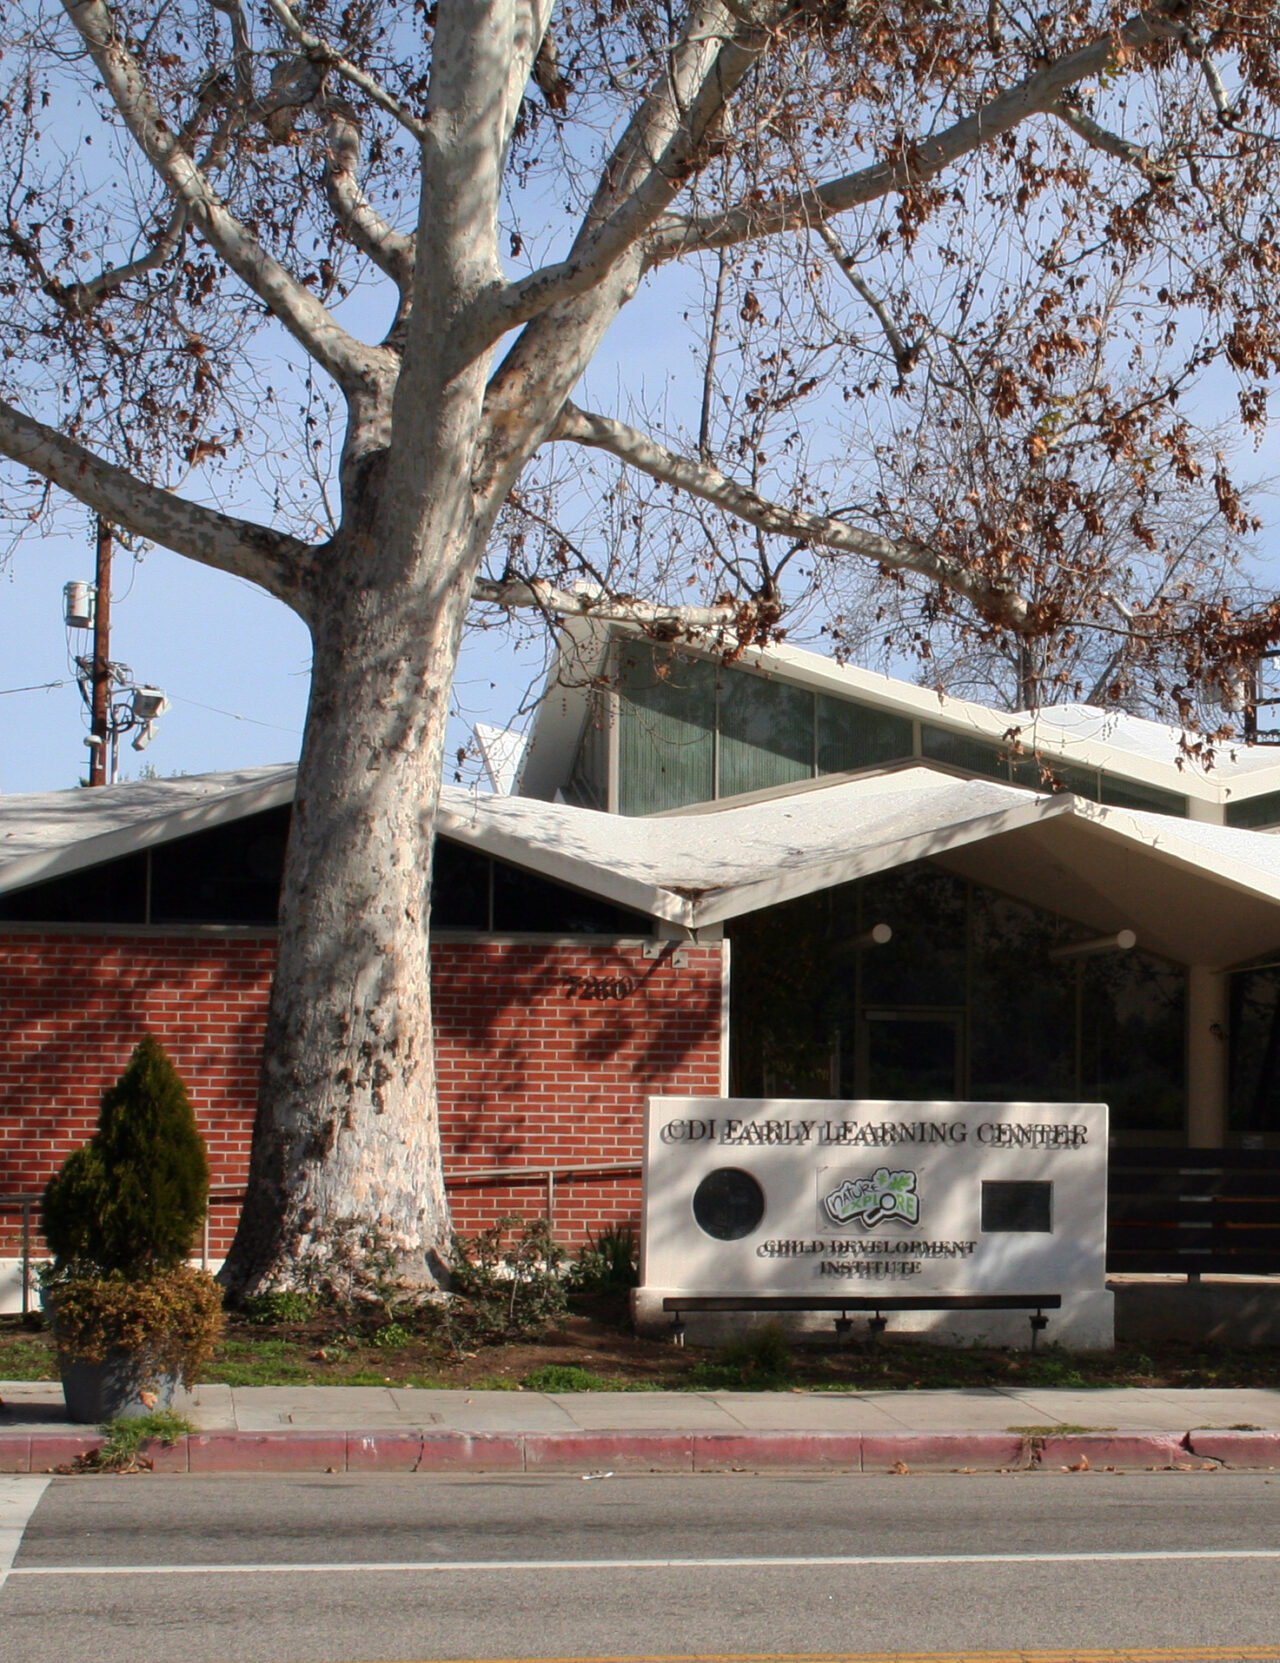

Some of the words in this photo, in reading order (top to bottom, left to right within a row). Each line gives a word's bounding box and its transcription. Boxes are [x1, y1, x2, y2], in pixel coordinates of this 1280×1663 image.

[667, 1117, 716, 1141] CDI
[726, 1118, 816, 1142] EARLY
[825, 1120, 967, 1143] LEARNING
[977, 1122, 1089, 1145] CENTER
[841, 1193, 915, 1217] EXPLORE
[763, 1239, 825, 1255] CHILD
[830, 1239, 978, 1256] DEVELOPMENT
[819, 1260, 922, 1275] INSTITUTE
